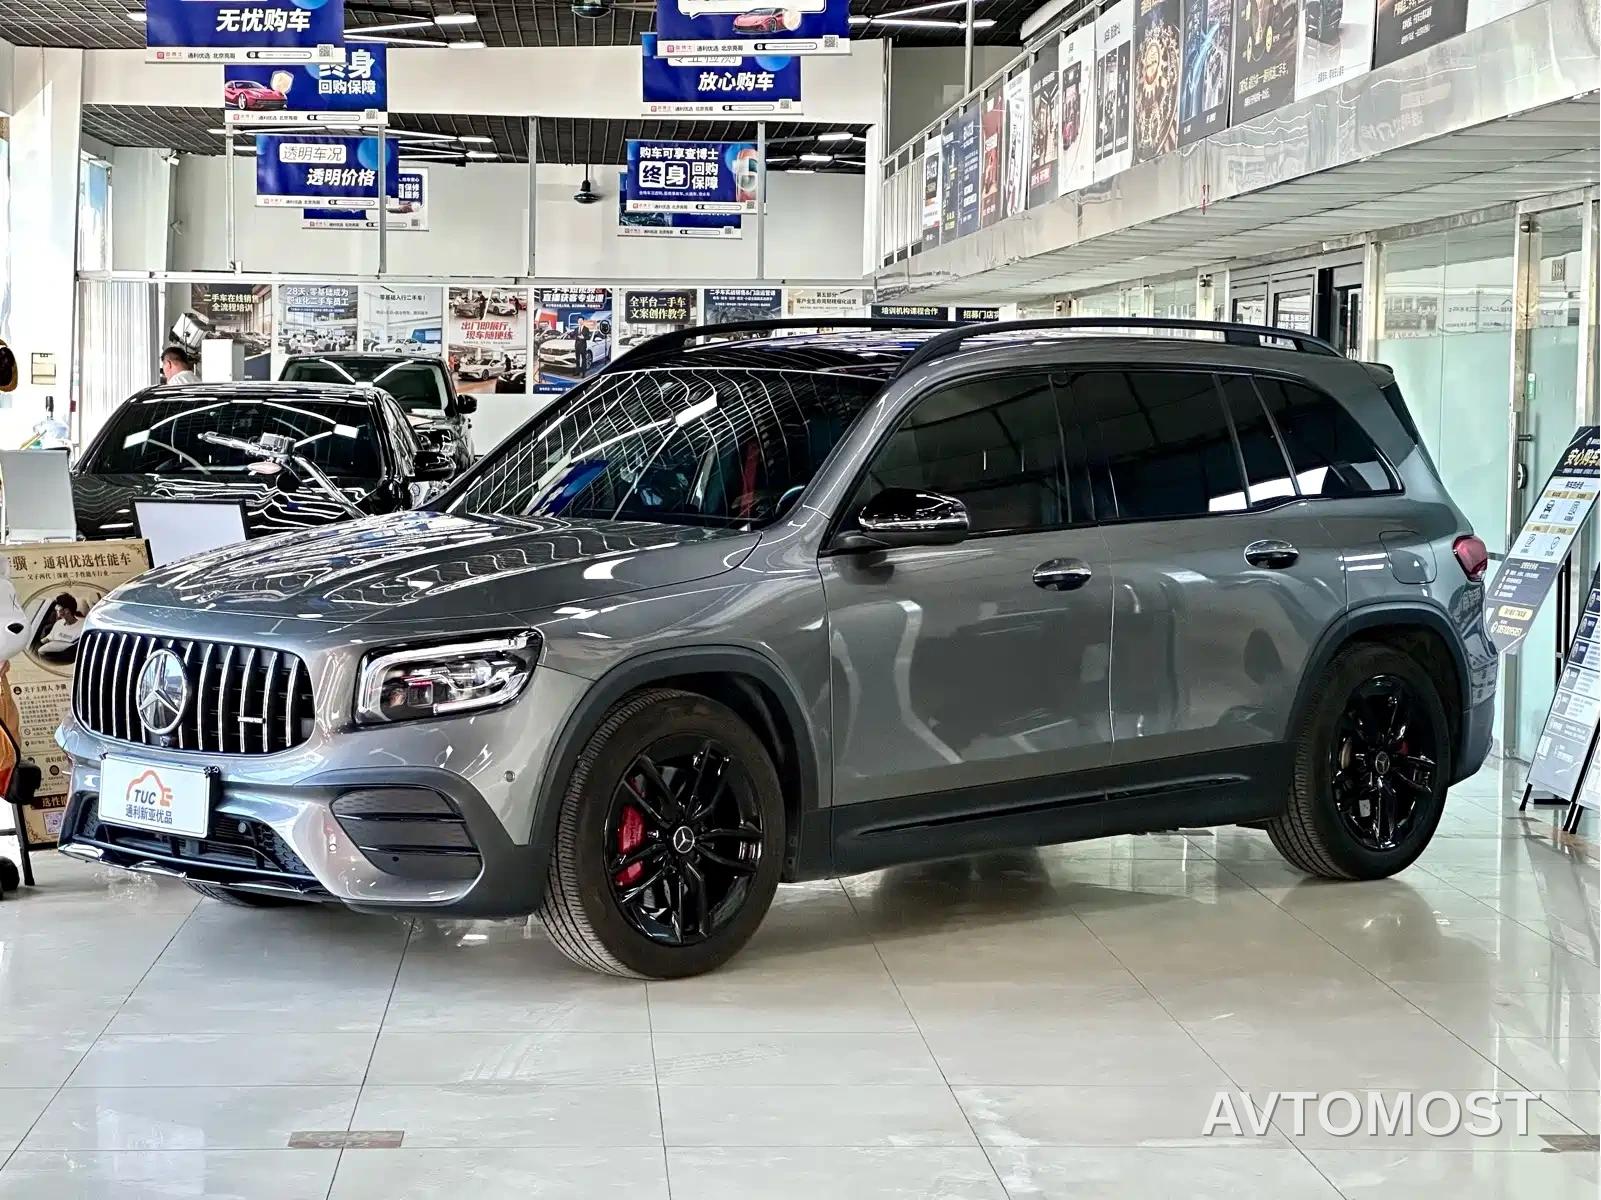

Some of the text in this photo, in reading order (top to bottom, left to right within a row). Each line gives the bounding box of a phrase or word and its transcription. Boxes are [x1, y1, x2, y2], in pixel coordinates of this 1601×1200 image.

[216, 8, 311, 32] 无忧购车
[318, 79, 376, 95] 回购保障
[697, 71, 775, 92] 放心购车
[283, 145, 342, 162] 透明车况
[639, 146, 719, 160] 购车可享查博士
[306, 168, 376, 187] 透明价格
[642, 161, 719, 185] 终身 回购
[692, 175, 719, 190] 保障
[203, 293, 259, 303] 二手车在线销售
[286, 296, 349, 306] 职业化二手车员工
[542, 293, 604, 302] 直播获客专业课
[629, 296, 687, 307] 全平台二手车
[211, 302, 253, 312] 全流程培训
[630, 307, 687, 320] 文案创作教学
[881, 306, 939, 316] 培训机构课程合作
[134, 789, 157, 805] TUC
[125, 804, 173, 825] 通利新亚优品
